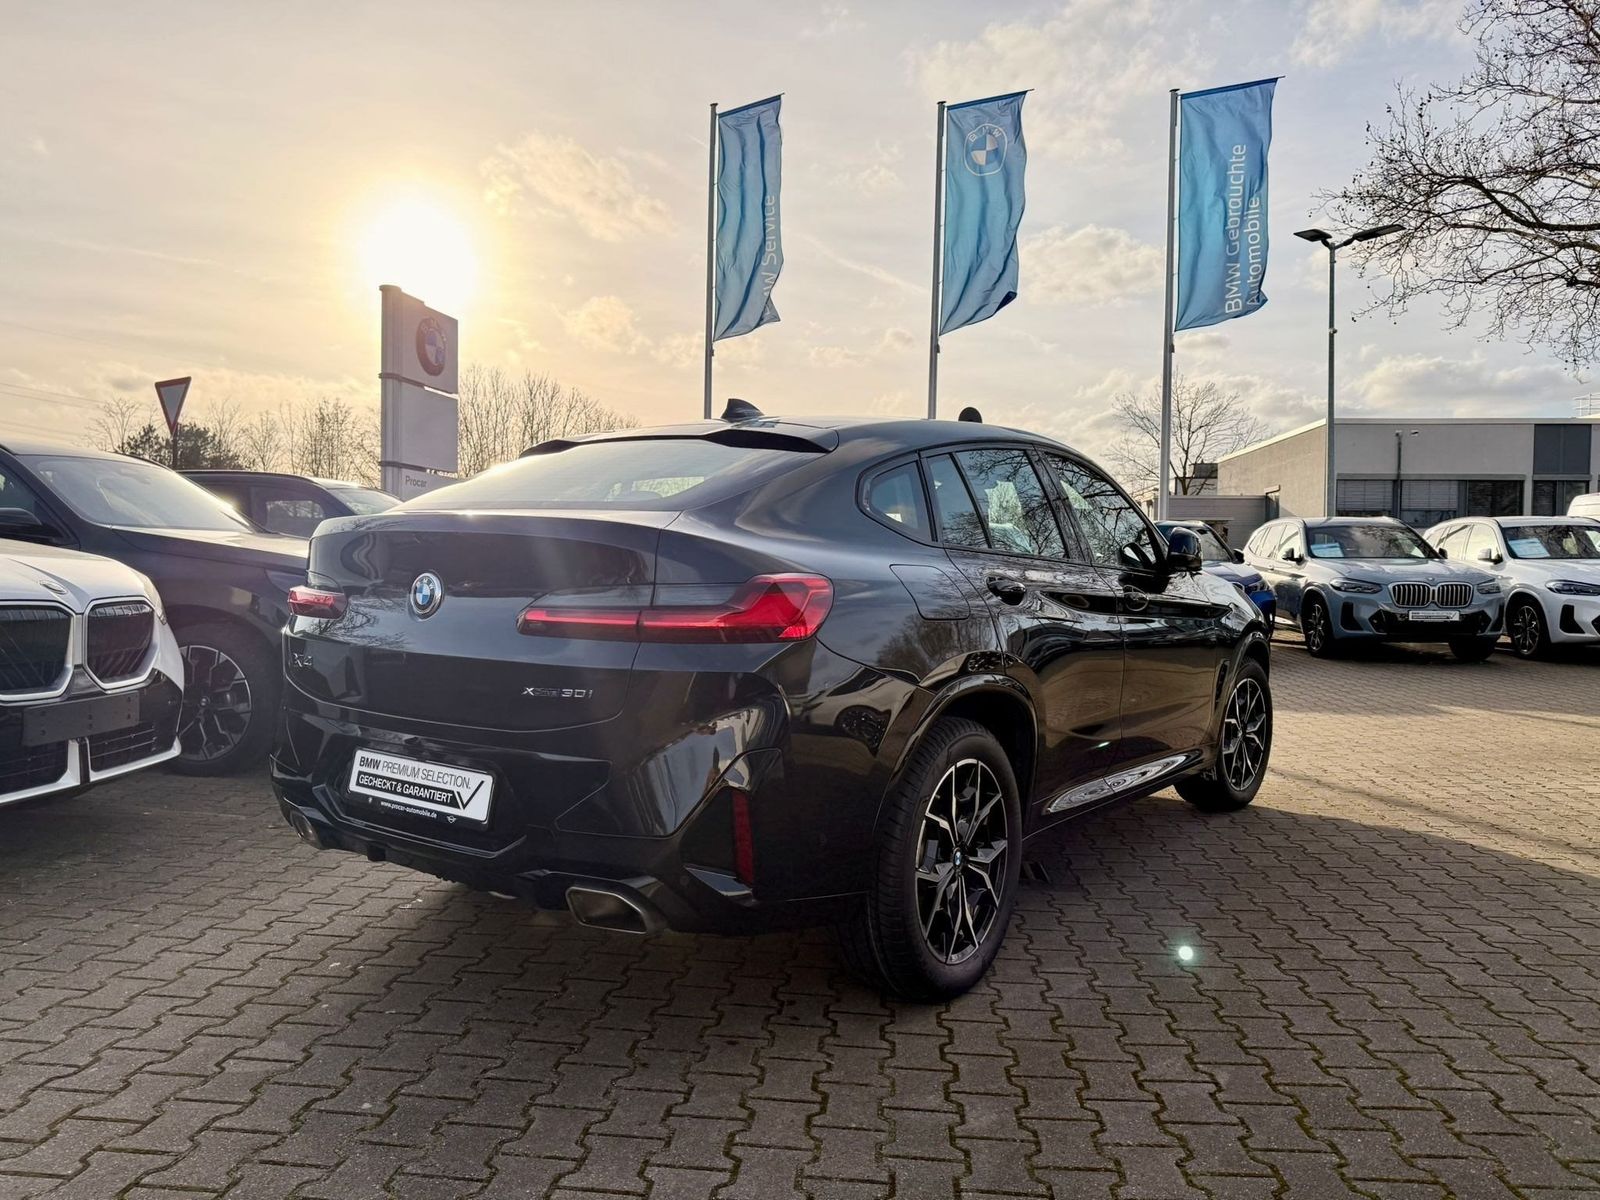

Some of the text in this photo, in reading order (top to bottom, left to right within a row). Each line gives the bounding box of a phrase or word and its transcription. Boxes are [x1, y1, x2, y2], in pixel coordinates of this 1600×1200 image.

[1225, 144, 1246, 314] BMW Gebrauchte
[1243, 197, 1261, 305] Automobile
[359, 756, 381, 770] BMW
[382, 760, 420, 780] PREMIUM
[359, 774, 453, 803] GECHECKT & GARANTIERT
[380, 800, 437, 819] www.procar-automobile.de
